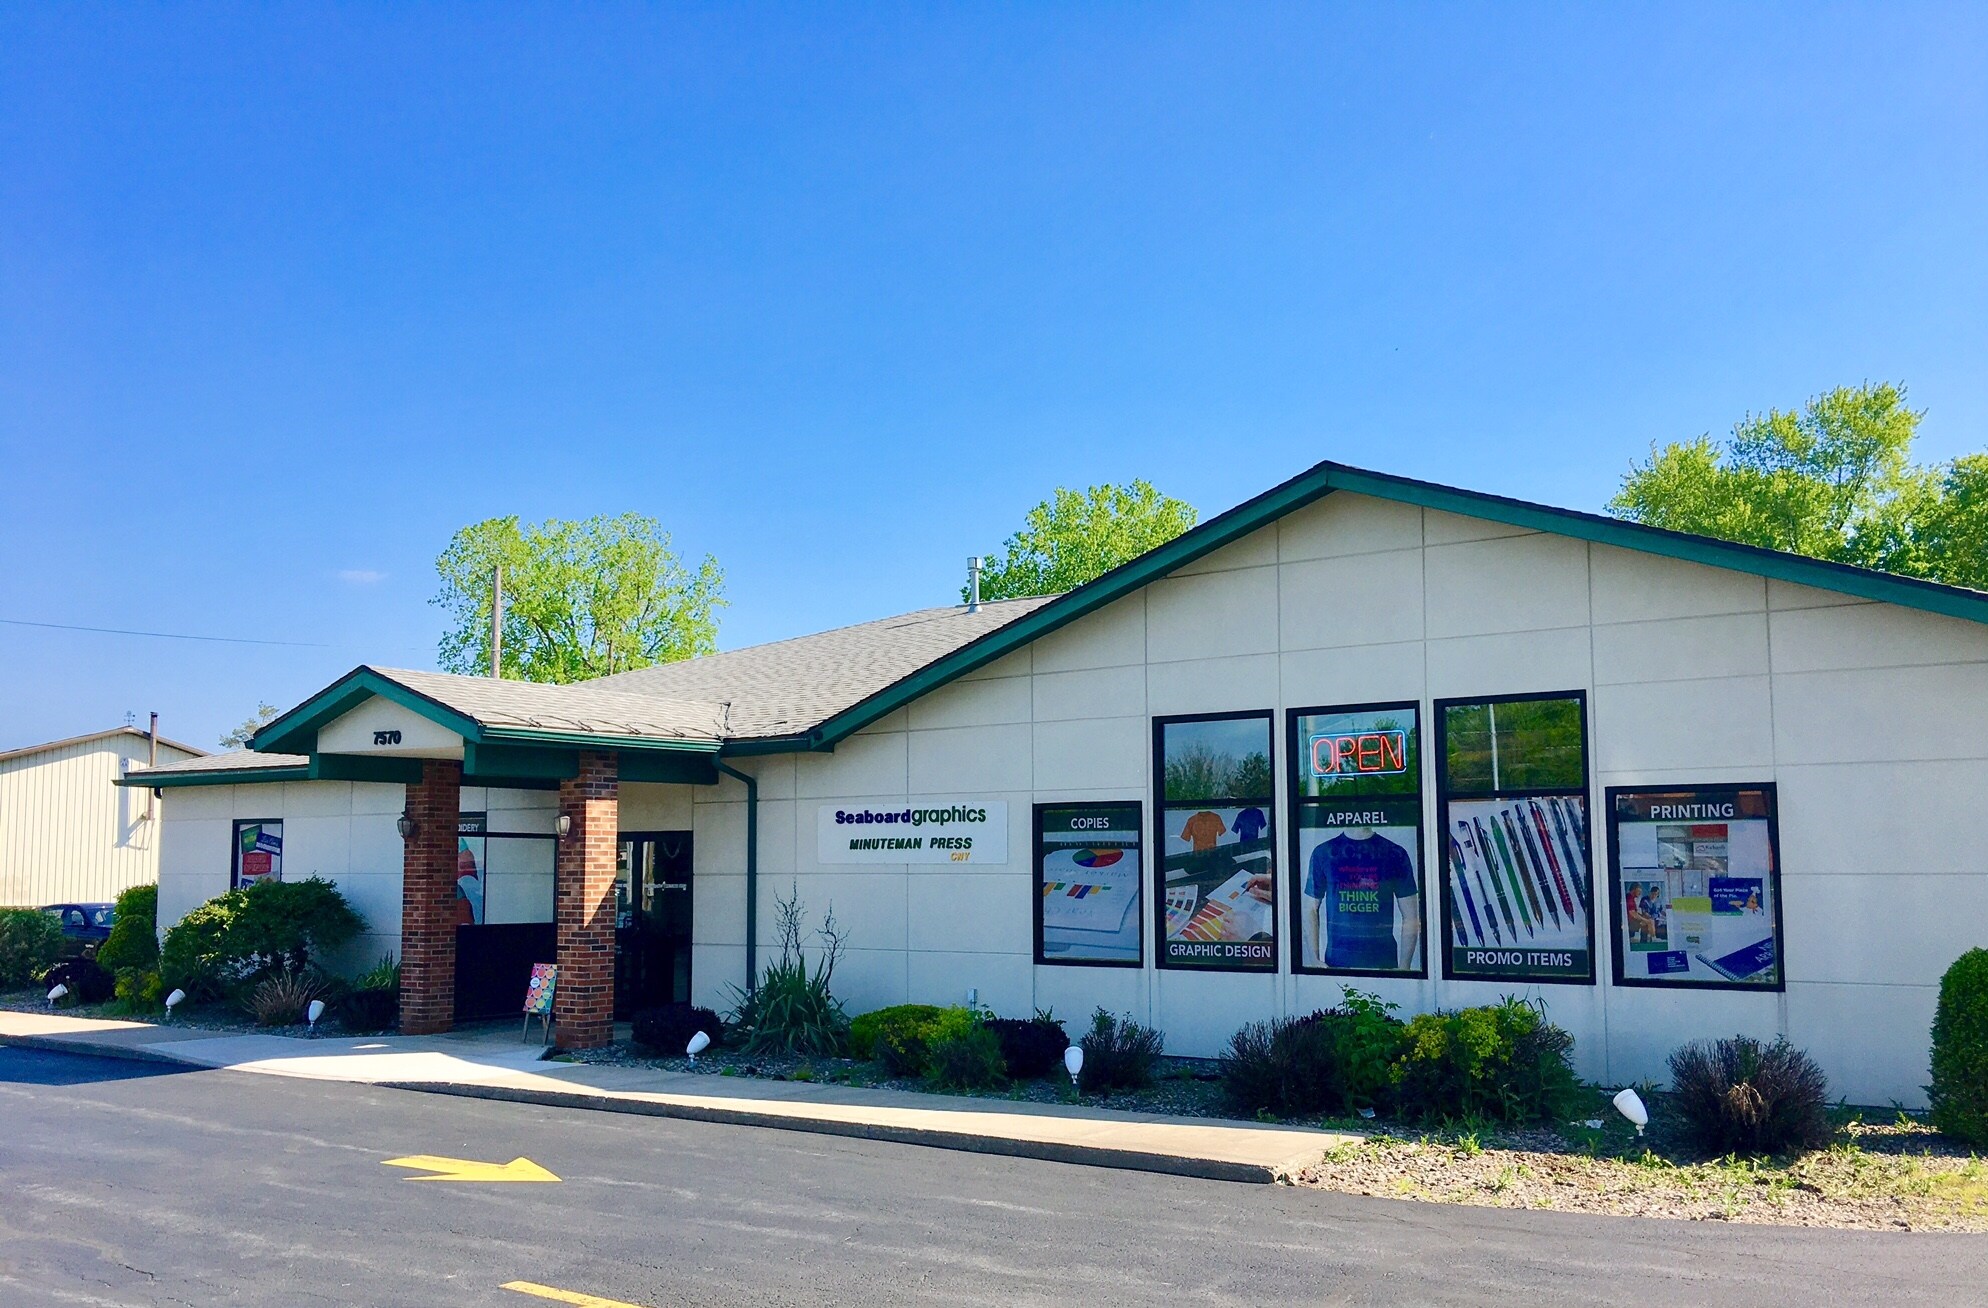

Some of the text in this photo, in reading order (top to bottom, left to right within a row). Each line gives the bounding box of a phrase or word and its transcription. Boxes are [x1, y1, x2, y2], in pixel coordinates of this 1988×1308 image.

[373, 730, 402, 745] 7570
[1313, 735, 1404, 773] OPEN
[835, 805, 987, 826] Seaboardgraphics
[1326, 811, 1388, 825] APPAREL
[1650, 803, 1734, 819] PRINTING
[1070, 817, 1110, 830] COPIES
[849, 837, 973, 850] MINUTEMAN PRESS
[1338, 890, 1379, 902] THINK
[1338, 902, 1380, 913] BIGGER
[1169, 944, 1271, 958] GRAPHIC DESIGN
[1467, 951, 1572, 967] PROMO ITEMS
